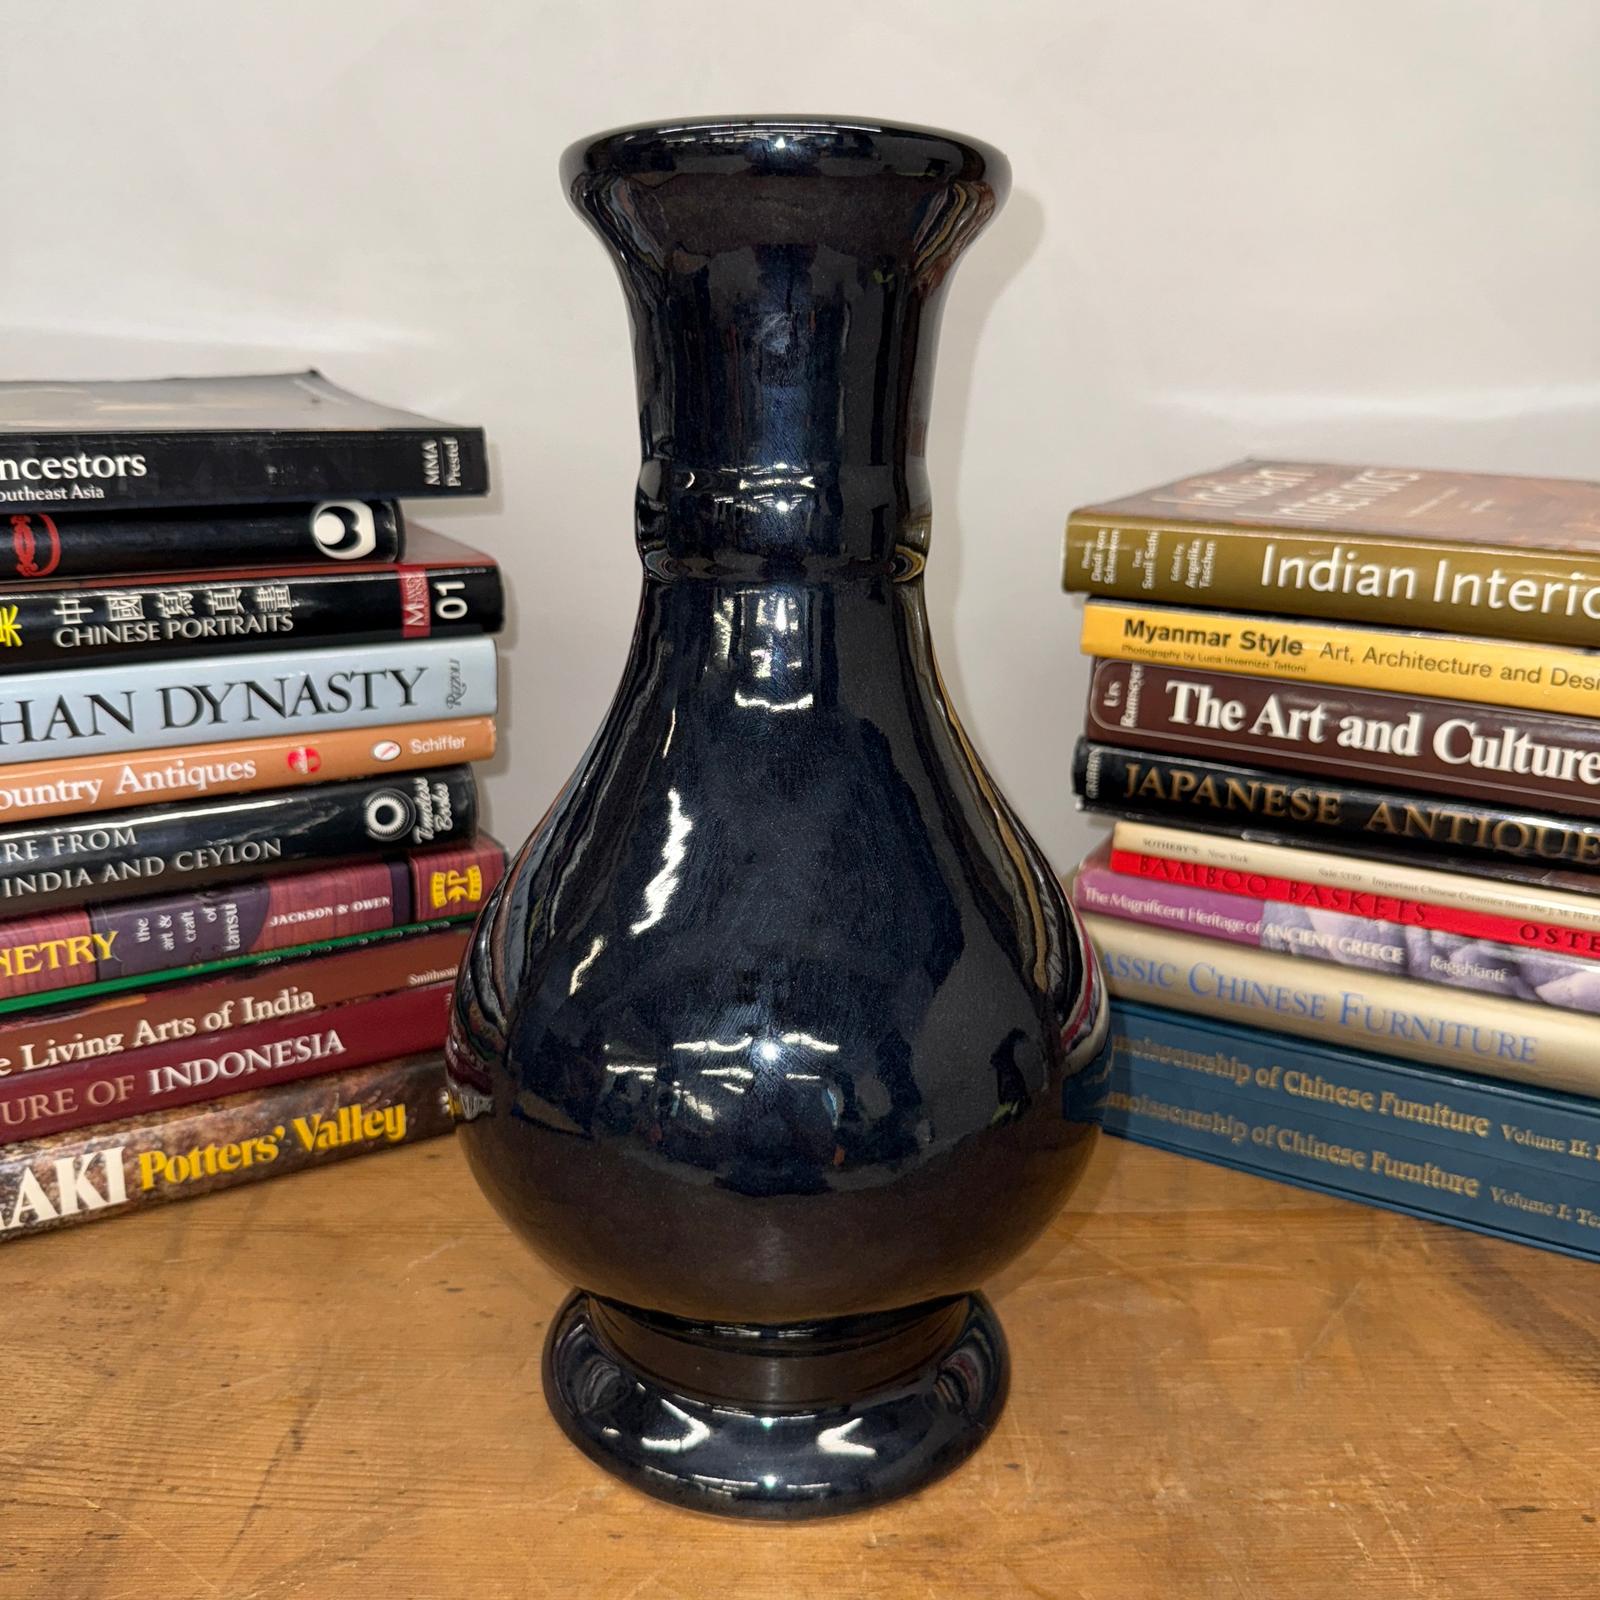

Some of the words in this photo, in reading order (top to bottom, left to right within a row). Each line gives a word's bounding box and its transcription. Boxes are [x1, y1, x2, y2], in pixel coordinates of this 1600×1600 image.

[0, 451, 147, 481] ncestors
[421, 438, 441, 486] MMA
[442, 437, 462, 487] Prestel
[70, 484, 105, 499] Asia
[1185, 539, 1201, 589] Angelika
[1199, 540, 1217, 589] Taschen
[1260, 543, 1416, 600] Indian
[433, 580, 468, 620] 01
[54, 622, 161, 648] CHINESE
[167, 611, 294, 640] PORTRAITS
[1121, 645, 1181, 660] Photography
[1183, 651, 1195, 662] by
[1198, 653, 1222, 664] Luca
[1123, 618, 1232, 646] Myanmar
[1238, 629, 1304, 658] Style
[1318, 641, 1355, 664] Art,
[1361, 645, 1493, 679] Architecture
[1500, 664, 1542, 684] and
[0, 690, 136, 745] HAN
[156, 665, 429, 731] DYNASTY
[409, 734, 467, 755] Schiffer
[1165, 679, 1247, 732] The
[1248, 692, 1328, 745] Art
[1336, 711, 1424, 757] and
[1432, 717, 1600, 785] Culture
[115, 759, 257, 796] Antiques
[1124, 762, 1342, 825] JAPANESE
[431, 781, 453, 833] Books
[52, 827, 139, 857] FROM
[3, 866, 94, 899] INDIA
[102, 855, 166, 884] AND
[173, 837, 282, 873] CEYLON
[1139, 854, 1269, 894] BAMBOO
[1288, 880, 1428, 924] BASKETS
[1229, 850, 1249, 865] York
[1372, 875, 1419, 894] Important
[1420, 882, 1457, 899] Chinese
[135, 916, 151, 943] the
[158, 913, 173, 929] &
[180, 909, 197, 943] craft
[202, 905, 217, 922] of
[268, 904, 335, 928] JACKSON
[337, 902, 351, 916] &
[352, 895, 392, 912] OWEN
[1084, 886, 1109, 906] The
[1109, 892, 1187, 921] Magnificent
[1187, 906, 1244, 935] Heritage
[1243, 919, 1262, 935] of
[1262, 921, 1337, 948] ANCIENT
[1338, 936, 1405, 965] GREECE
[19, 1032, 125, 1072] Living
[132, 1015, 197, 1047] Arts
[203, 1000, 235, 1032] of
[241, 986, 317, 1026] India
[1187, 960, 1327, 1022] CHINESE
[1338, 991, 1538, 1064] FURNITURE
[1, 1086, 79, 1126] URE
[87, 1073, 137, 1108] OF
[148, 1028, 348, 1096] INDONESIA
[1255, 1064, 1282, 1089] of
[1283, 1068, 1375, 1112] Chinese
[1379, 1090, 1492, 1137] Furniture
[1501, 1122, 1566, 1154] Volume
[137, 1124, 287, 1194] Potters'
[291, 1102, 408, 1152] Valley
[1251, 1124, 1277, 1147] of
[1277, 1127, 1367, 1171] Chinese
[1370, 1150, 1481, 1198] Furniture
[1489, 1184, 1555, 1217] Volume
[1575, 1207, 1600, 1230] Te
